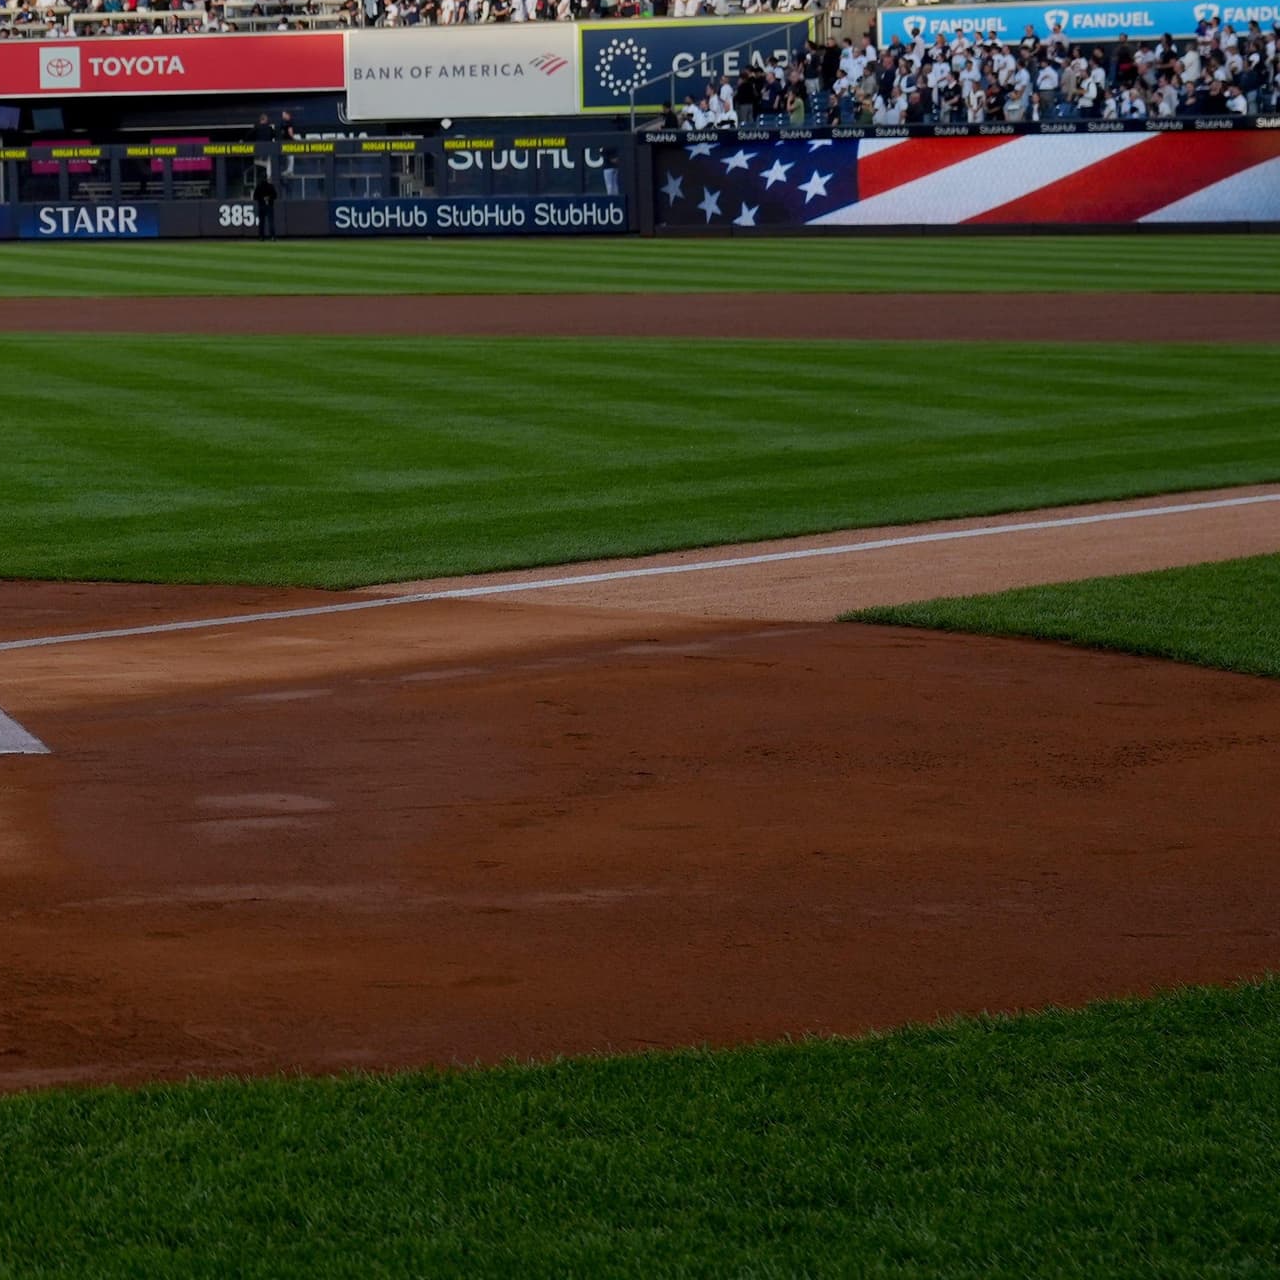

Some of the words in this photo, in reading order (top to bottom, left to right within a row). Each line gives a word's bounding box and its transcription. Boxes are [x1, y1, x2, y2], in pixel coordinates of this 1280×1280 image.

[930, 17, 1007, 34] FANDUEL
[1073, 11, 1154, 29] FANDUEL
[88, 56, 185, 77] TOYOTA
[354, 65, 404, 81] BANK
[410, 64, 433, 80] OF
[439, 62, 524, 78] AMERICA
[39, 205, 138, 234] STARR
[219, 205, 255, 227] 385
[335, 205, 428, 228] StubHub
[436, 204, 526, 227] StubHub
[534, 202, 624, 225] StubHub
